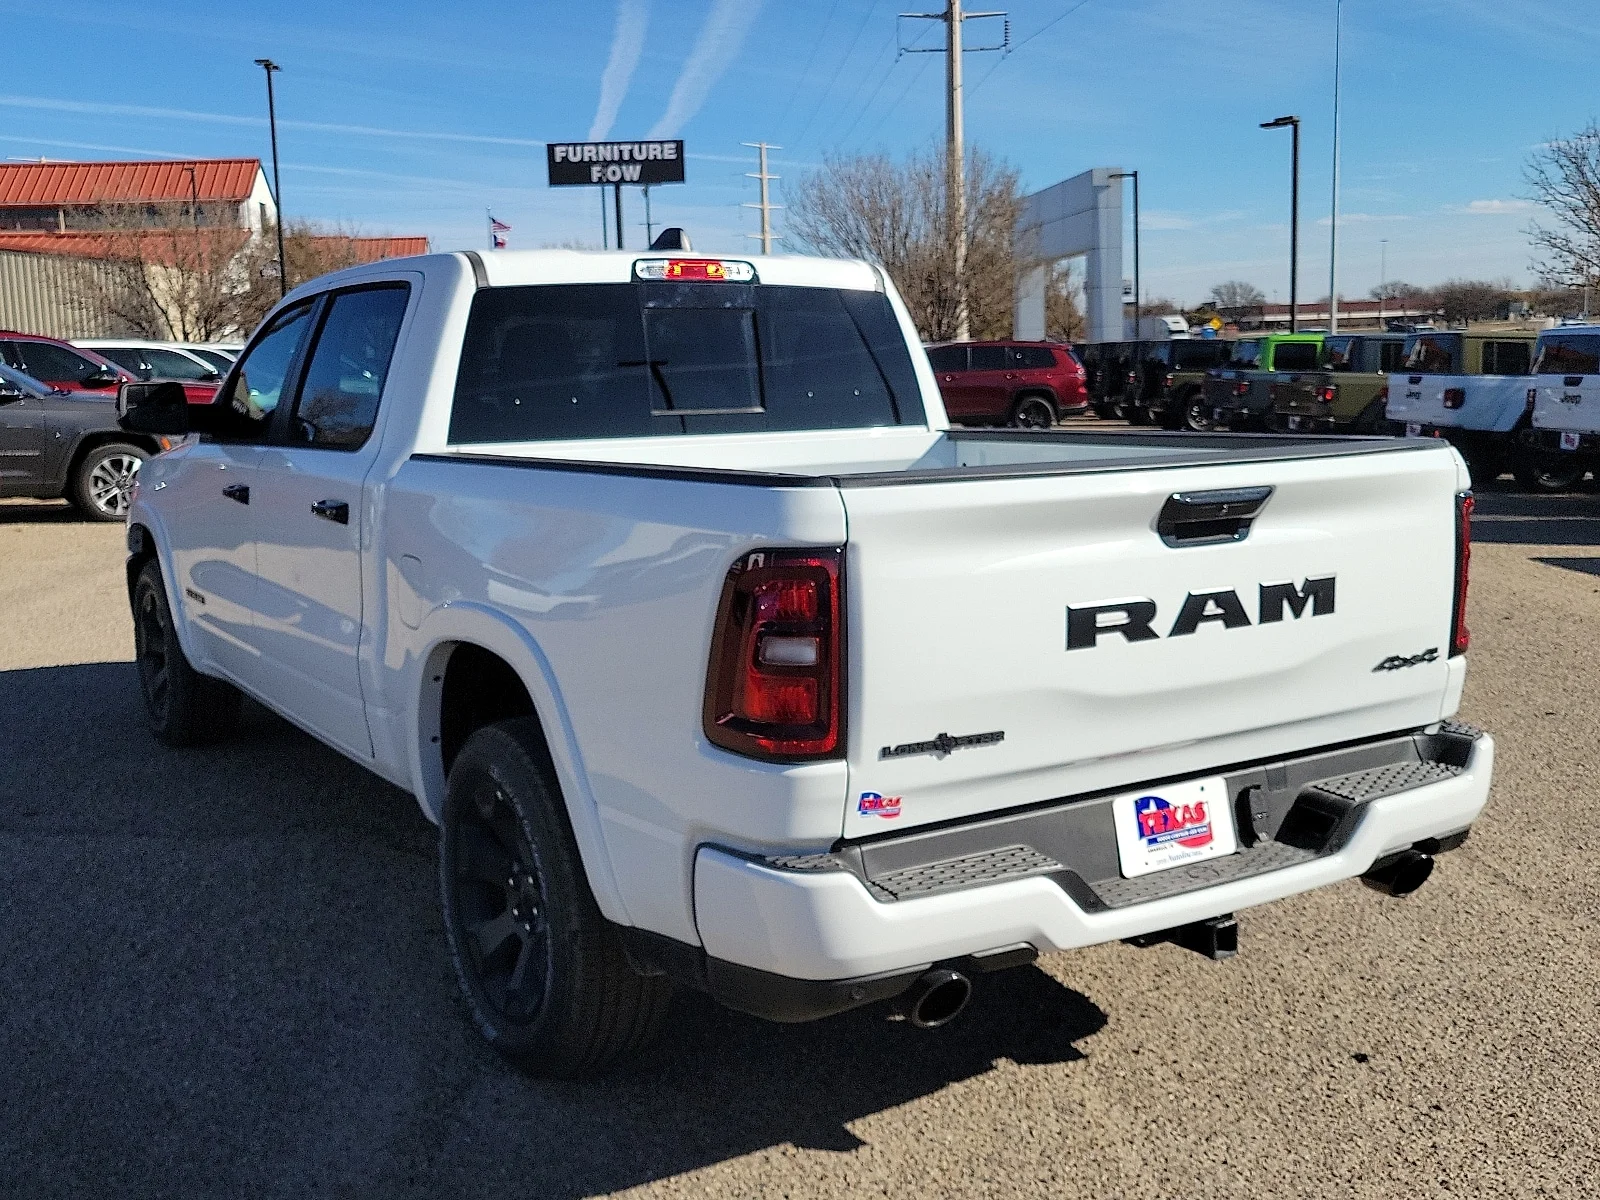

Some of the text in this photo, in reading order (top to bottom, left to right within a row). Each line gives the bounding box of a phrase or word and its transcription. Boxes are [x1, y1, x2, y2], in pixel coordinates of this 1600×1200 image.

[554, 142, 678, 163] FURNITURE
[1066, 573, 1337, 651] RAM
[1138, 801, 1206, 836] TEXAS
